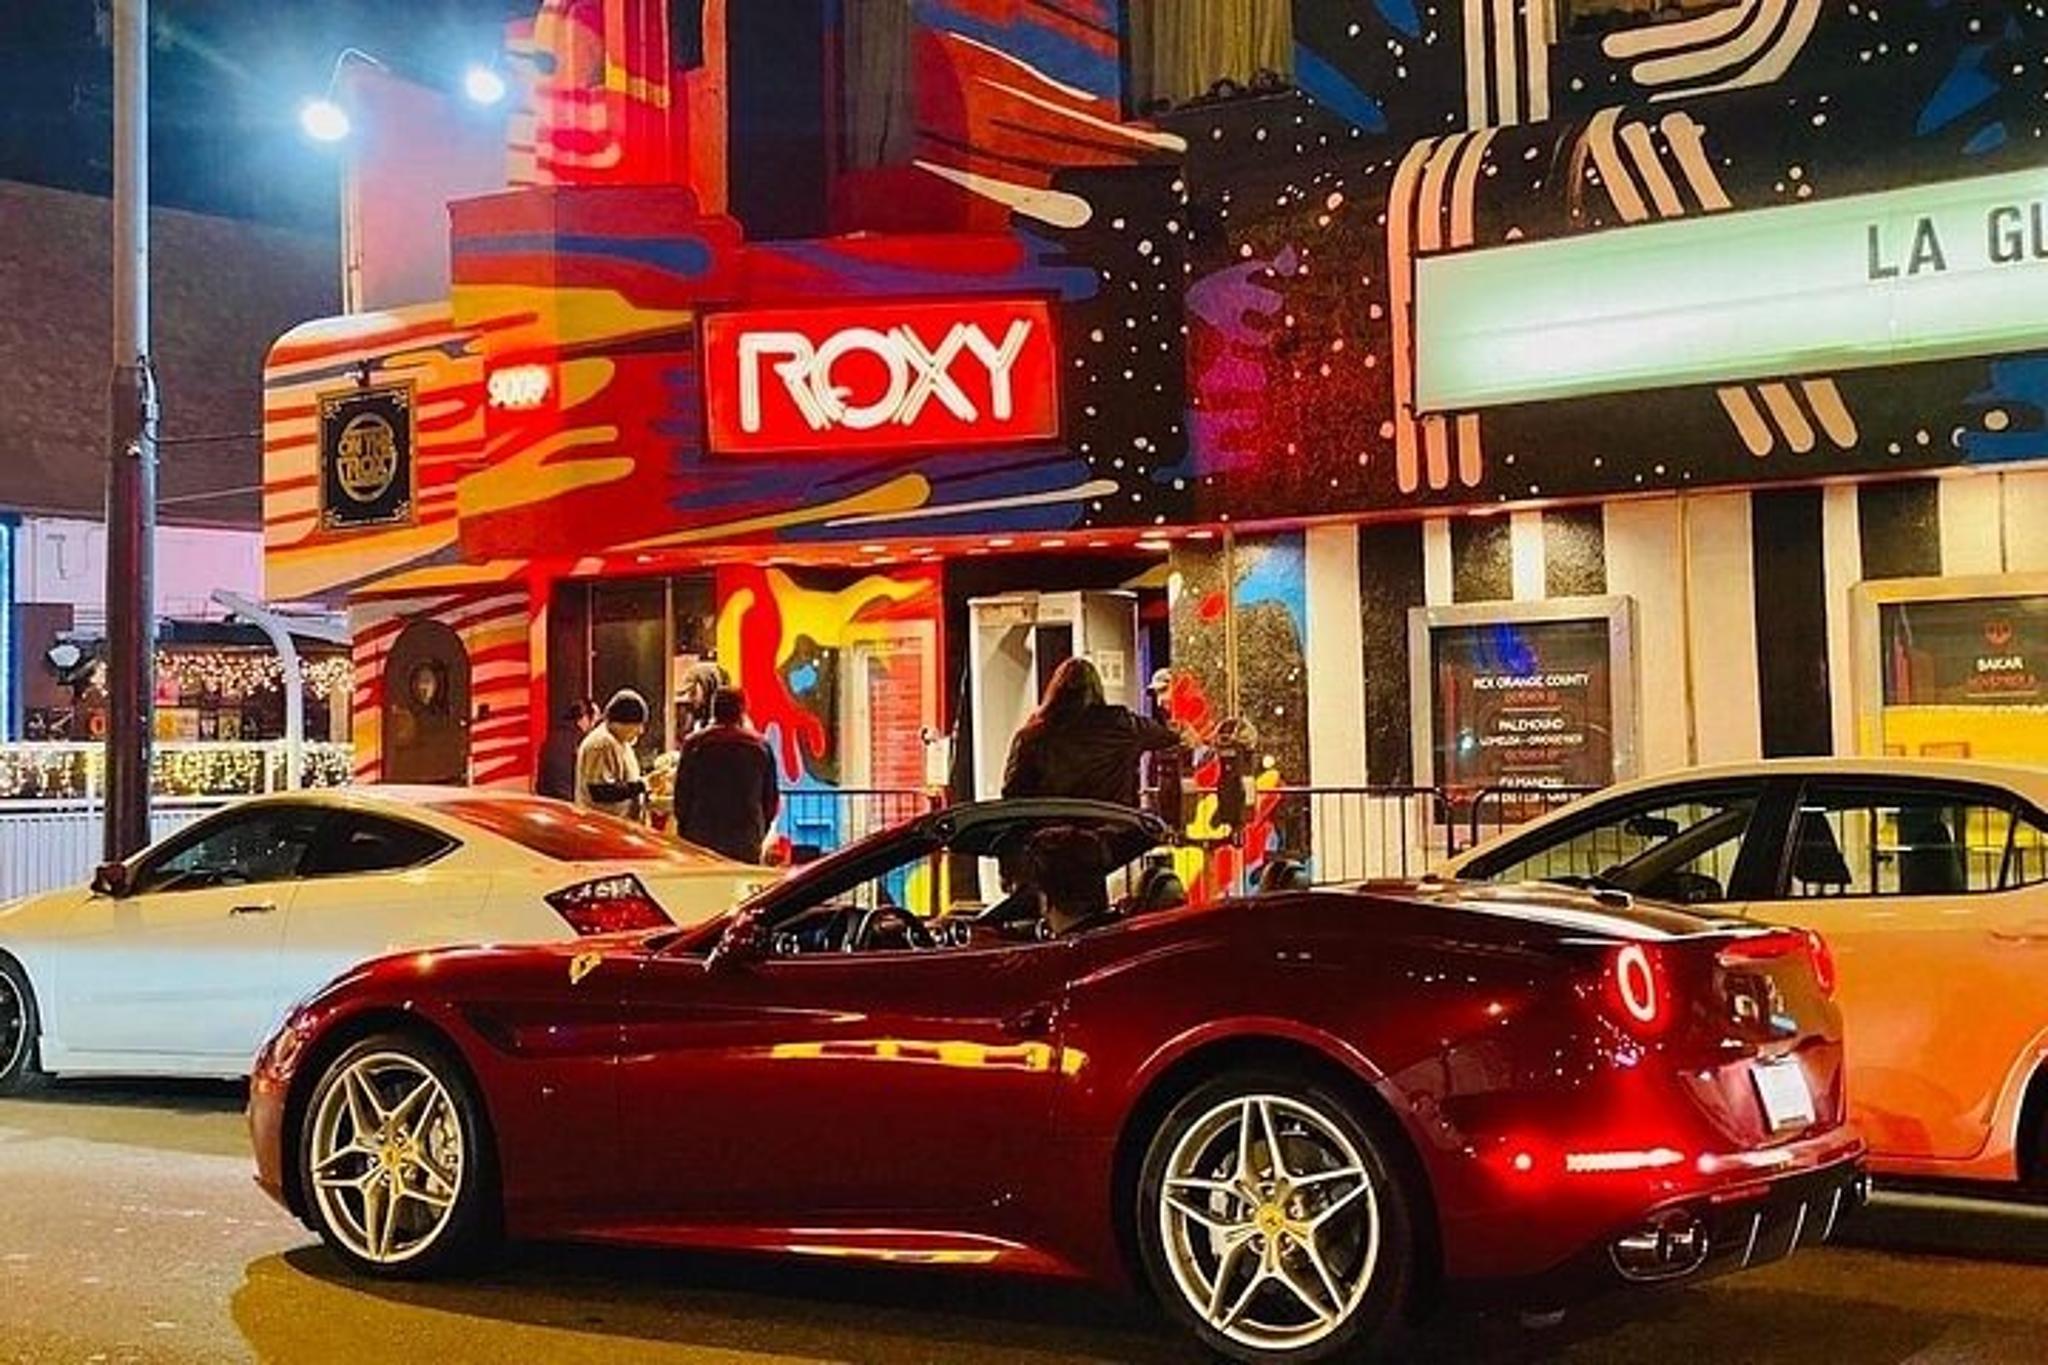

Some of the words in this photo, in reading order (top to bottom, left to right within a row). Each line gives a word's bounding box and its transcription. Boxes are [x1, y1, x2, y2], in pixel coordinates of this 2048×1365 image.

[1868, 217, 1947, 279] LA
[737, 319, 1032, 433] ROXY
[1498, 676, 1544, 689] ORANGE
[1546, 673, 1590, 686] COUNTY
[1976, 656, 2024, 672] BAKAR
